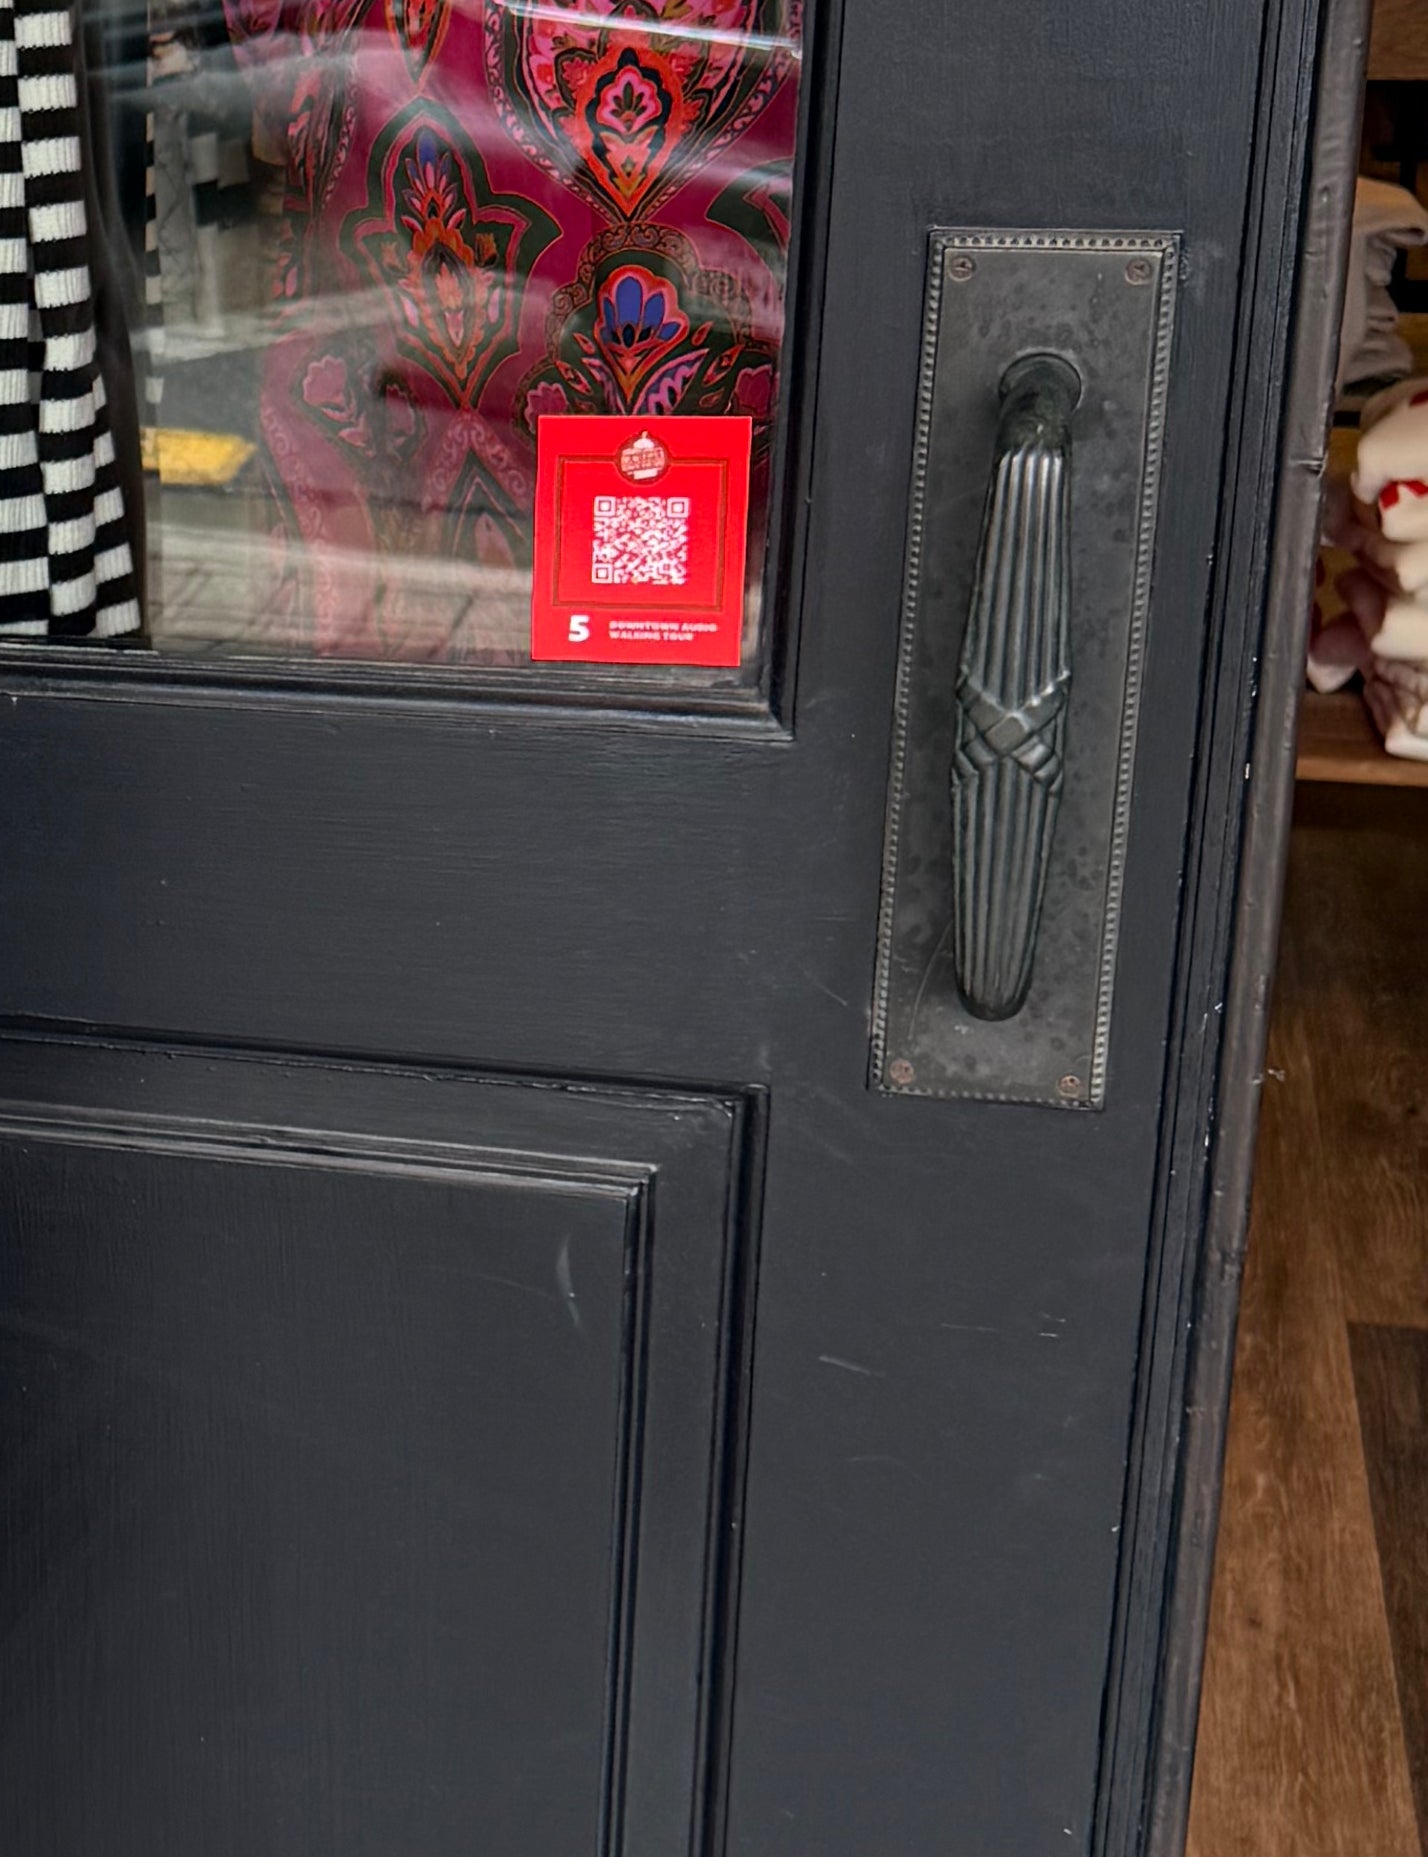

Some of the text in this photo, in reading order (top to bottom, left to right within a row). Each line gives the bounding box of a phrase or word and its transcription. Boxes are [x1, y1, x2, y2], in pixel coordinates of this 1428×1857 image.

[568, 615, 590, 642] 5
[609, 621, 718, 632] DOWNTOWN AUDIO
[608, 630, 694, 641] WALKING TOUR
